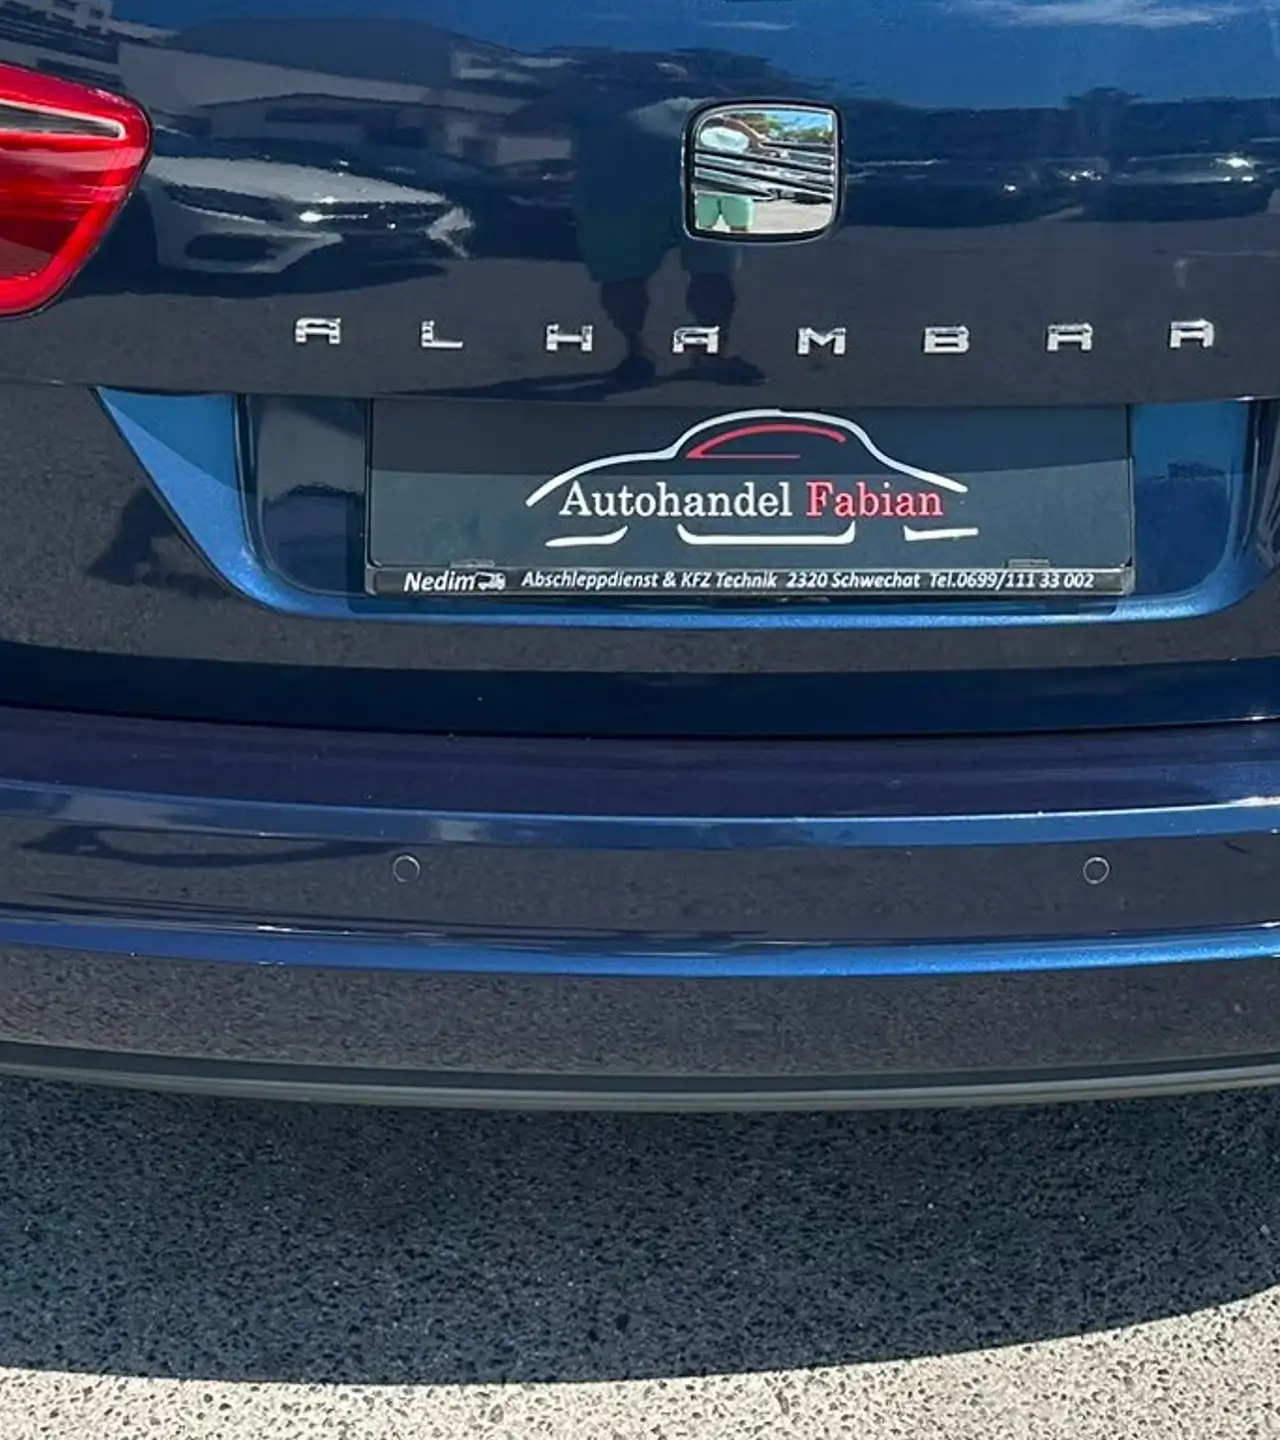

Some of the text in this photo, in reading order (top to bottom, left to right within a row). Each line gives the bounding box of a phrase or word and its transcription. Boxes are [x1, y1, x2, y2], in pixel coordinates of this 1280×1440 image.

[295, 315, 1216, 356] ALHAMBRA
[559, 482, 944, 517] Autohandel Fabian
[403, 570, 1096, 592] Nedim Abschleppdienst & KFZ Technik 2320 Schwechat Tel.0699/111 33 002
